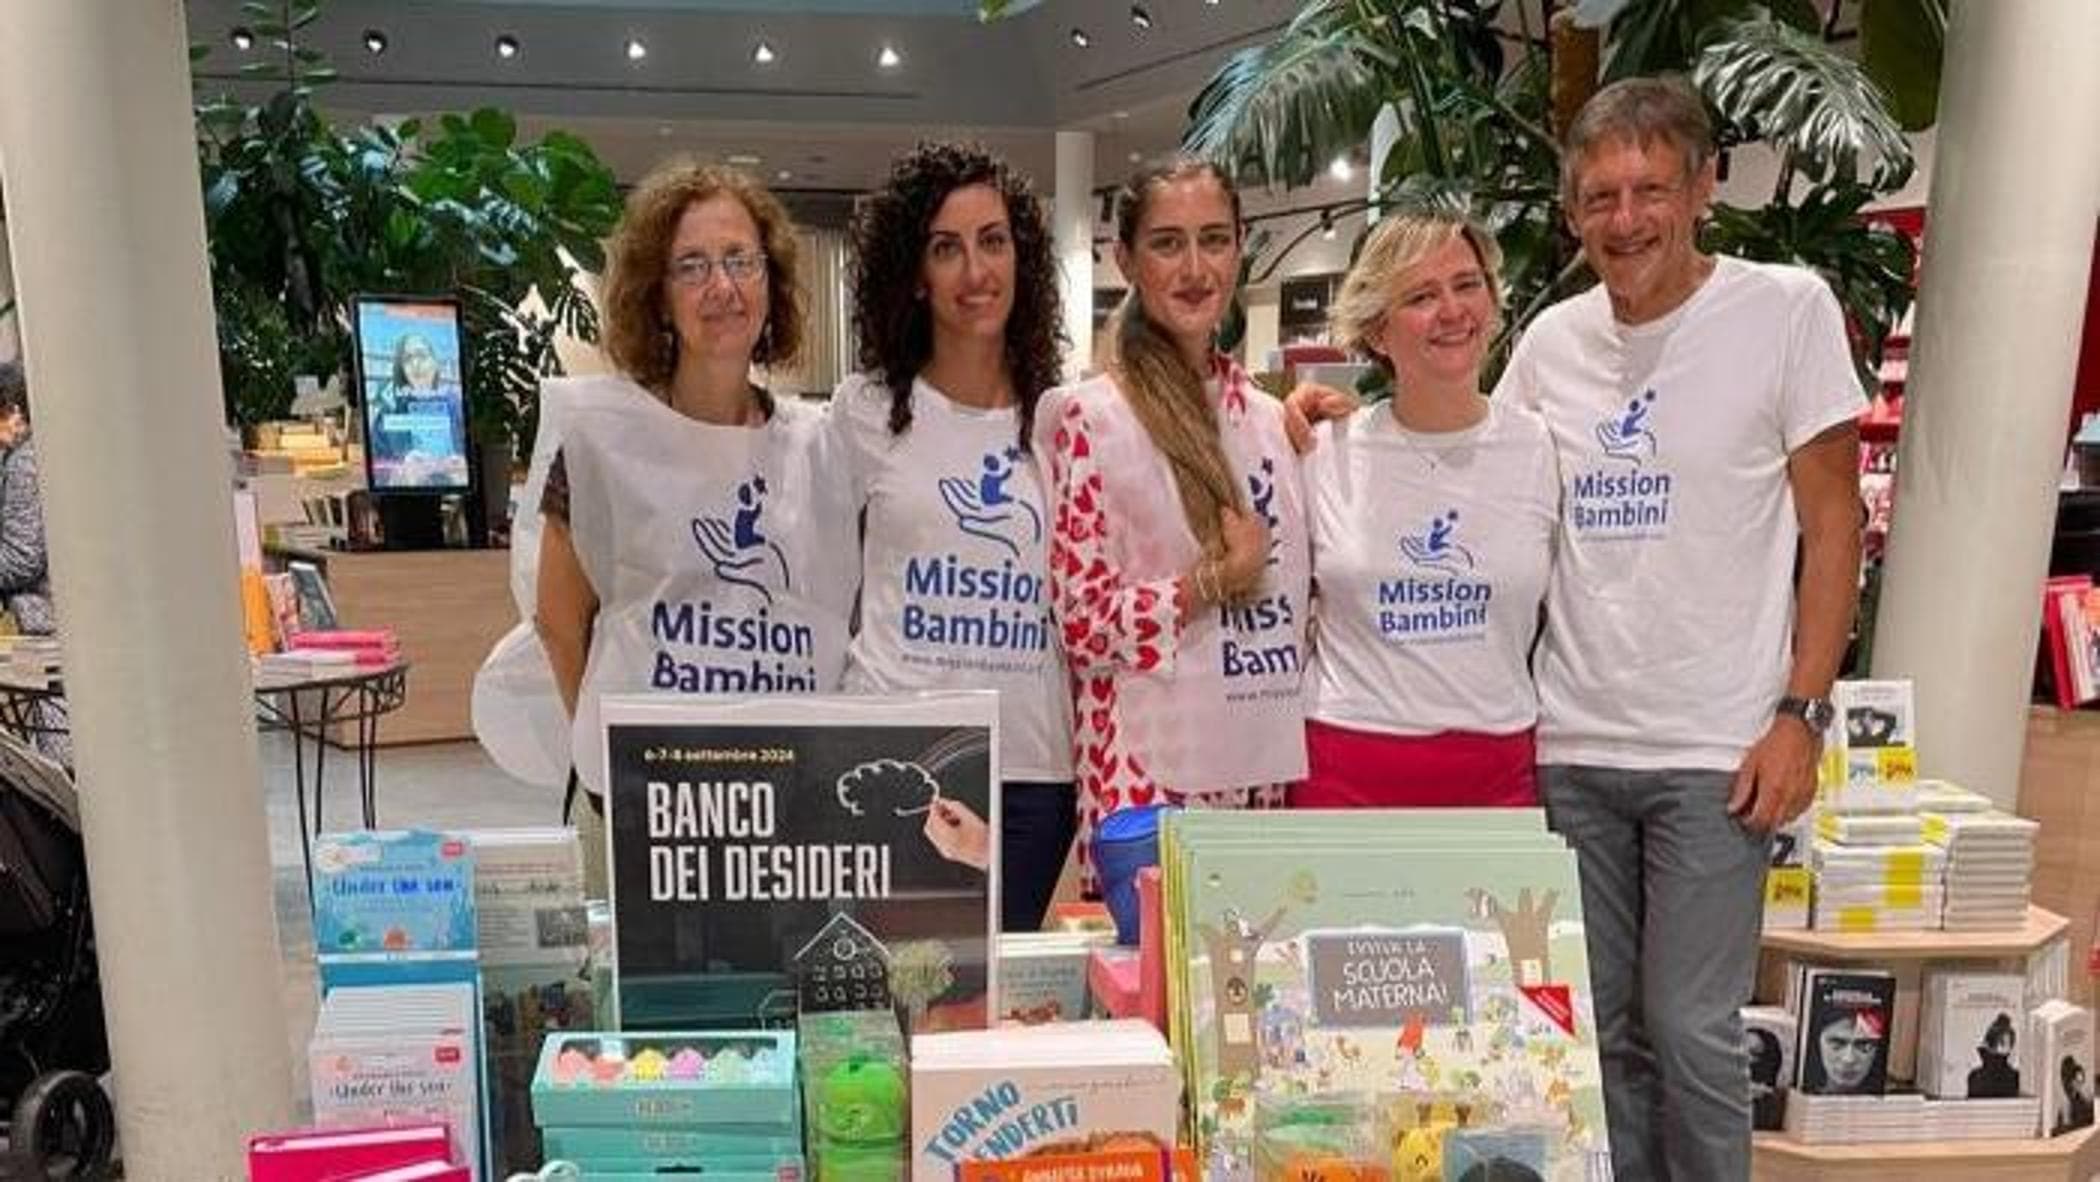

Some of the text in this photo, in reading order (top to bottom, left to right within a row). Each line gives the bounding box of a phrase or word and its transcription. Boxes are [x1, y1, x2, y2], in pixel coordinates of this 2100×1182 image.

[1574, 468, 1670, 498] Mission
[1574, 498, 1668, 530] Bambini
[1380, 577, 1491, 604] Mission
[652, 601, 813, 658] Mission
[904, 605, 1048, 649] Bambini
[1380, 604, 1485, 633] Bambini
[1223, 641, 1299, 676] Bam
[685, 748, 757, 761] settembre
[760, 748, 793, 761] 2024
[648, 782, 775, 838] BANCO
[650, 845, 889, 901] DEI DESIDERI
[1344, 957, 1434, 985] SCUOLA
[1333, 982, 1448, 1012] MATERNA!
[925, 1080, 1020, 1162] TORNO
[975, 1097, 1078, 1158] ENDERTI
